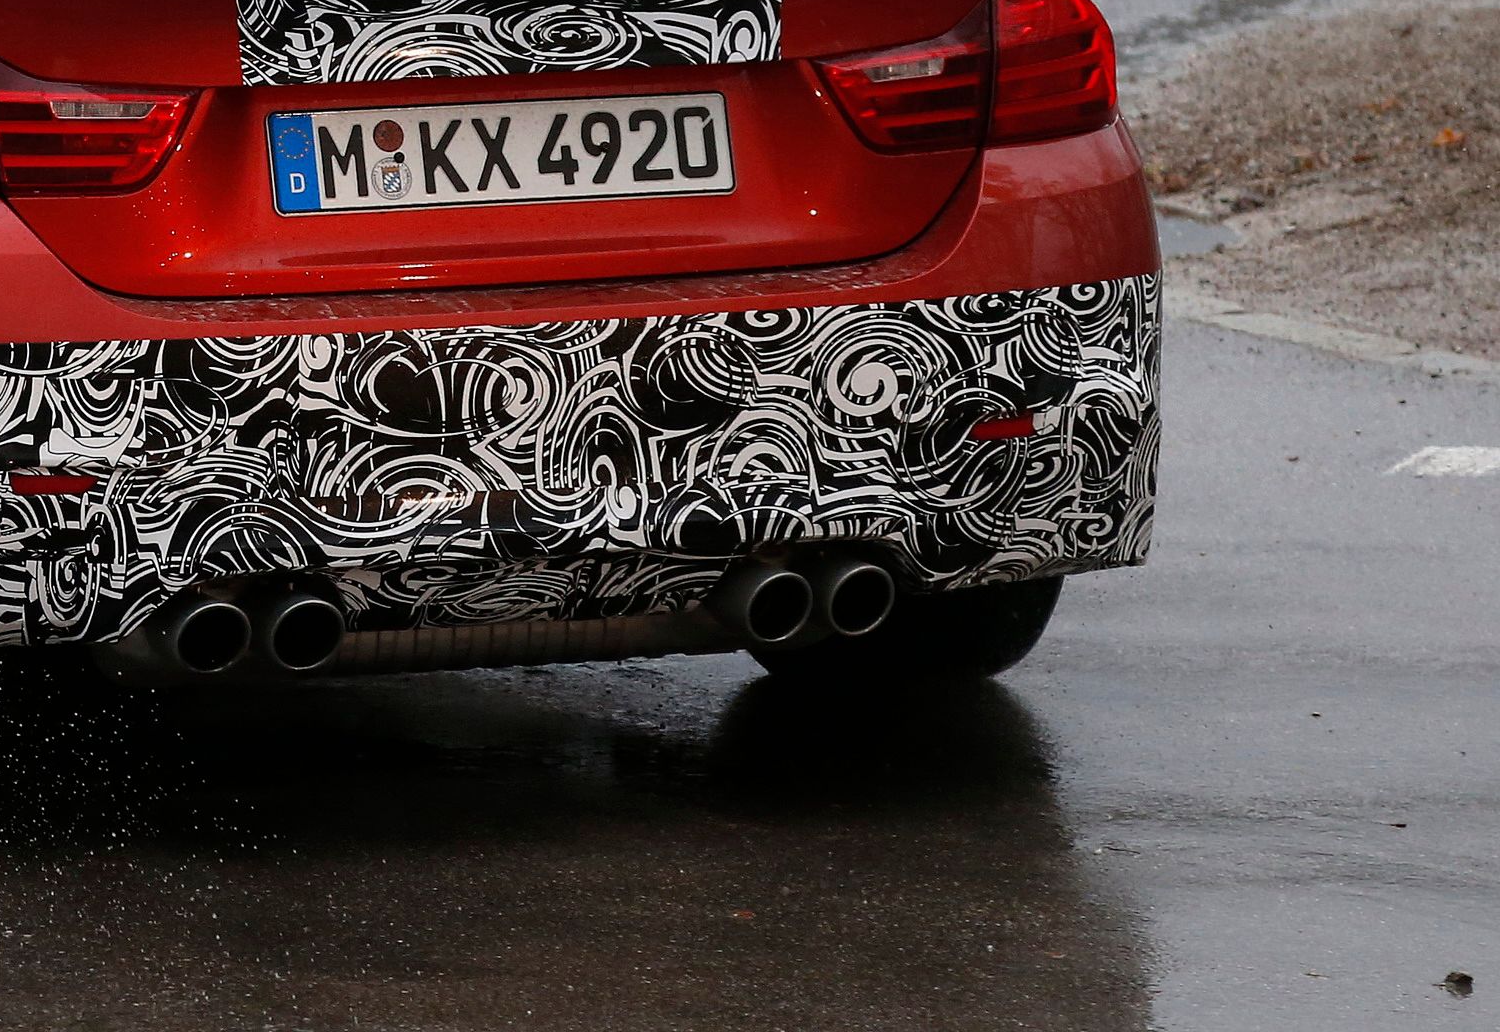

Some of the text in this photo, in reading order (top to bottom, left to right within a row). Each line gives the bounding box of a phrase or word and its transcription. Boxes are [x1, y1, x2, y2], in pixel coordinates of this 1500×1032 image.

[318, 124, 369, 199] M
[419, 117, 521, 194] KX
[537, 106, 720, 185] 4920
[289, 172, 306, 194] D
